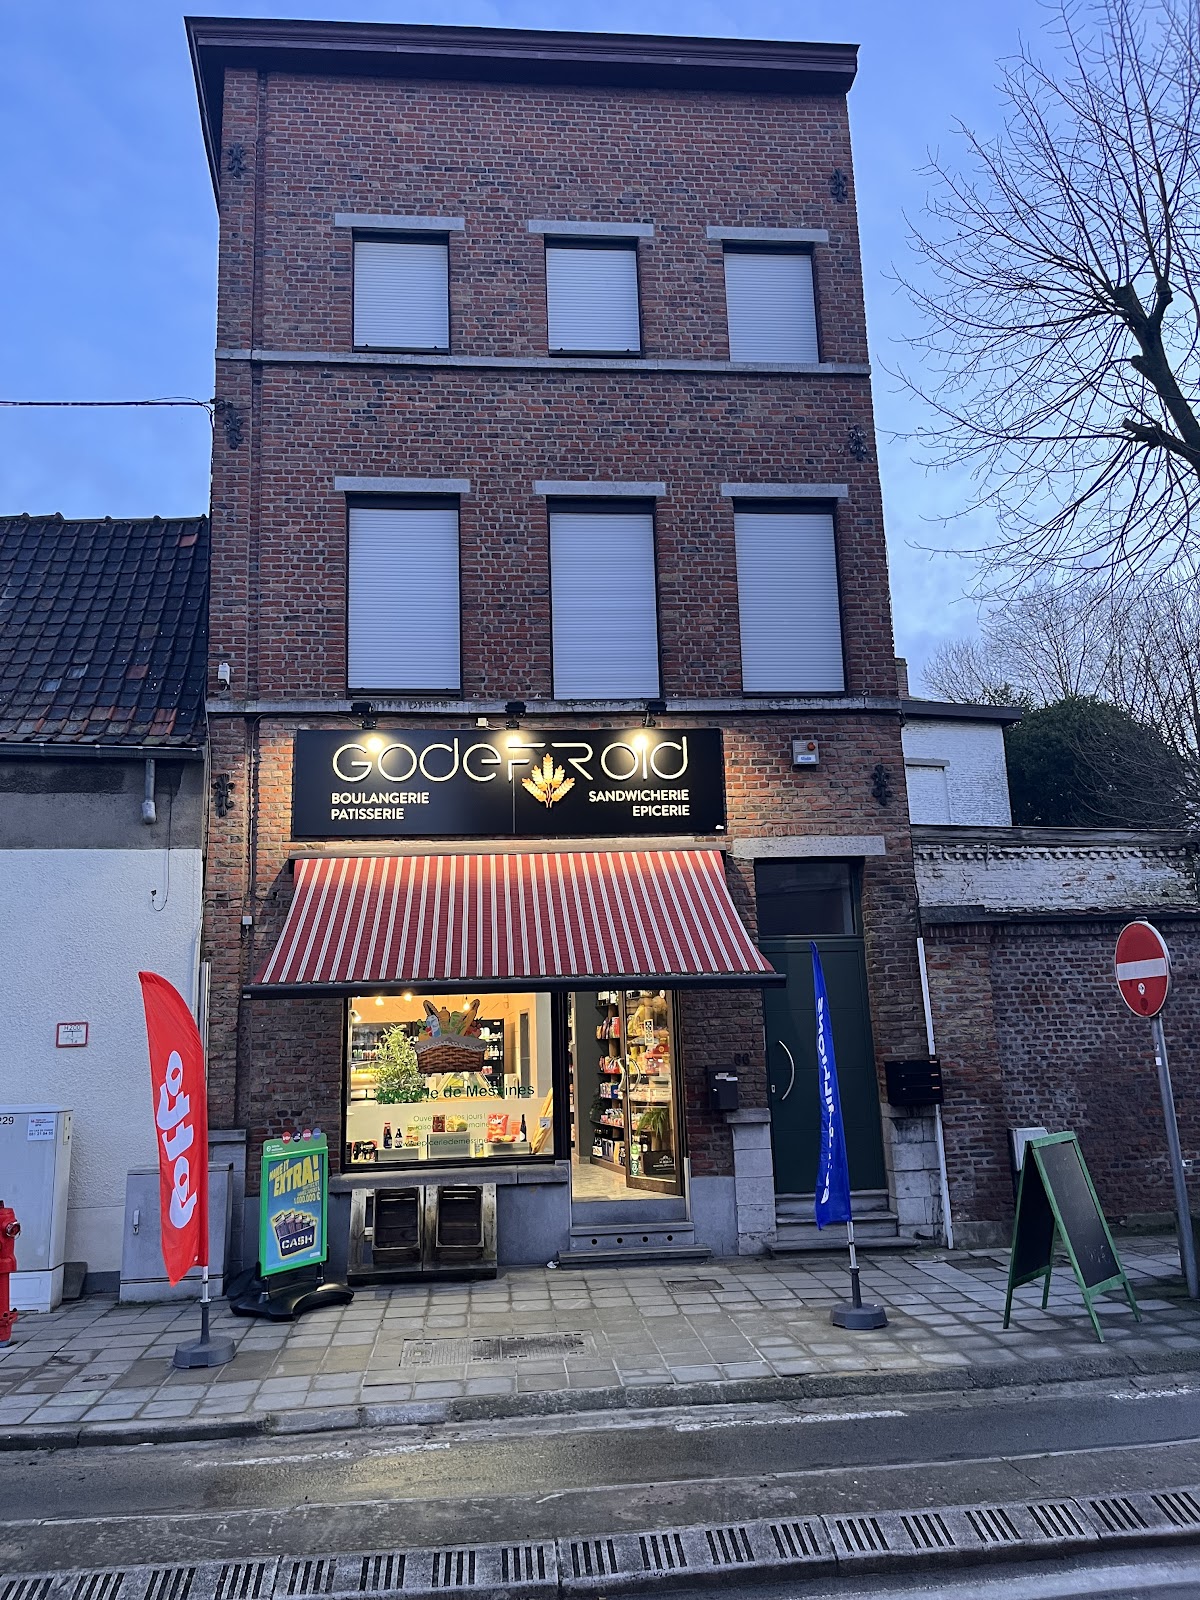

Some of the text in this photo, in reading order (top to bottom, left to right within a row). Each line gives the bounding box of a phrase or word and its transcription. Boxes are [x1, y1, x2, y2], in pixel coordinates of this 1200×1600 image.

[331, 792, 429, 804] BOULANGERIE
[589, 789, 689, 802] SANDWICHERIE
[331, 808, 404, 820] PATISSERIE
[632, 805, 690, 817] EPICERIE
[443, 1085, 462, 1098] de
[273, 1154, 320, 1197] EXTRA!
[281, 1234, 313, 1249] CASH
